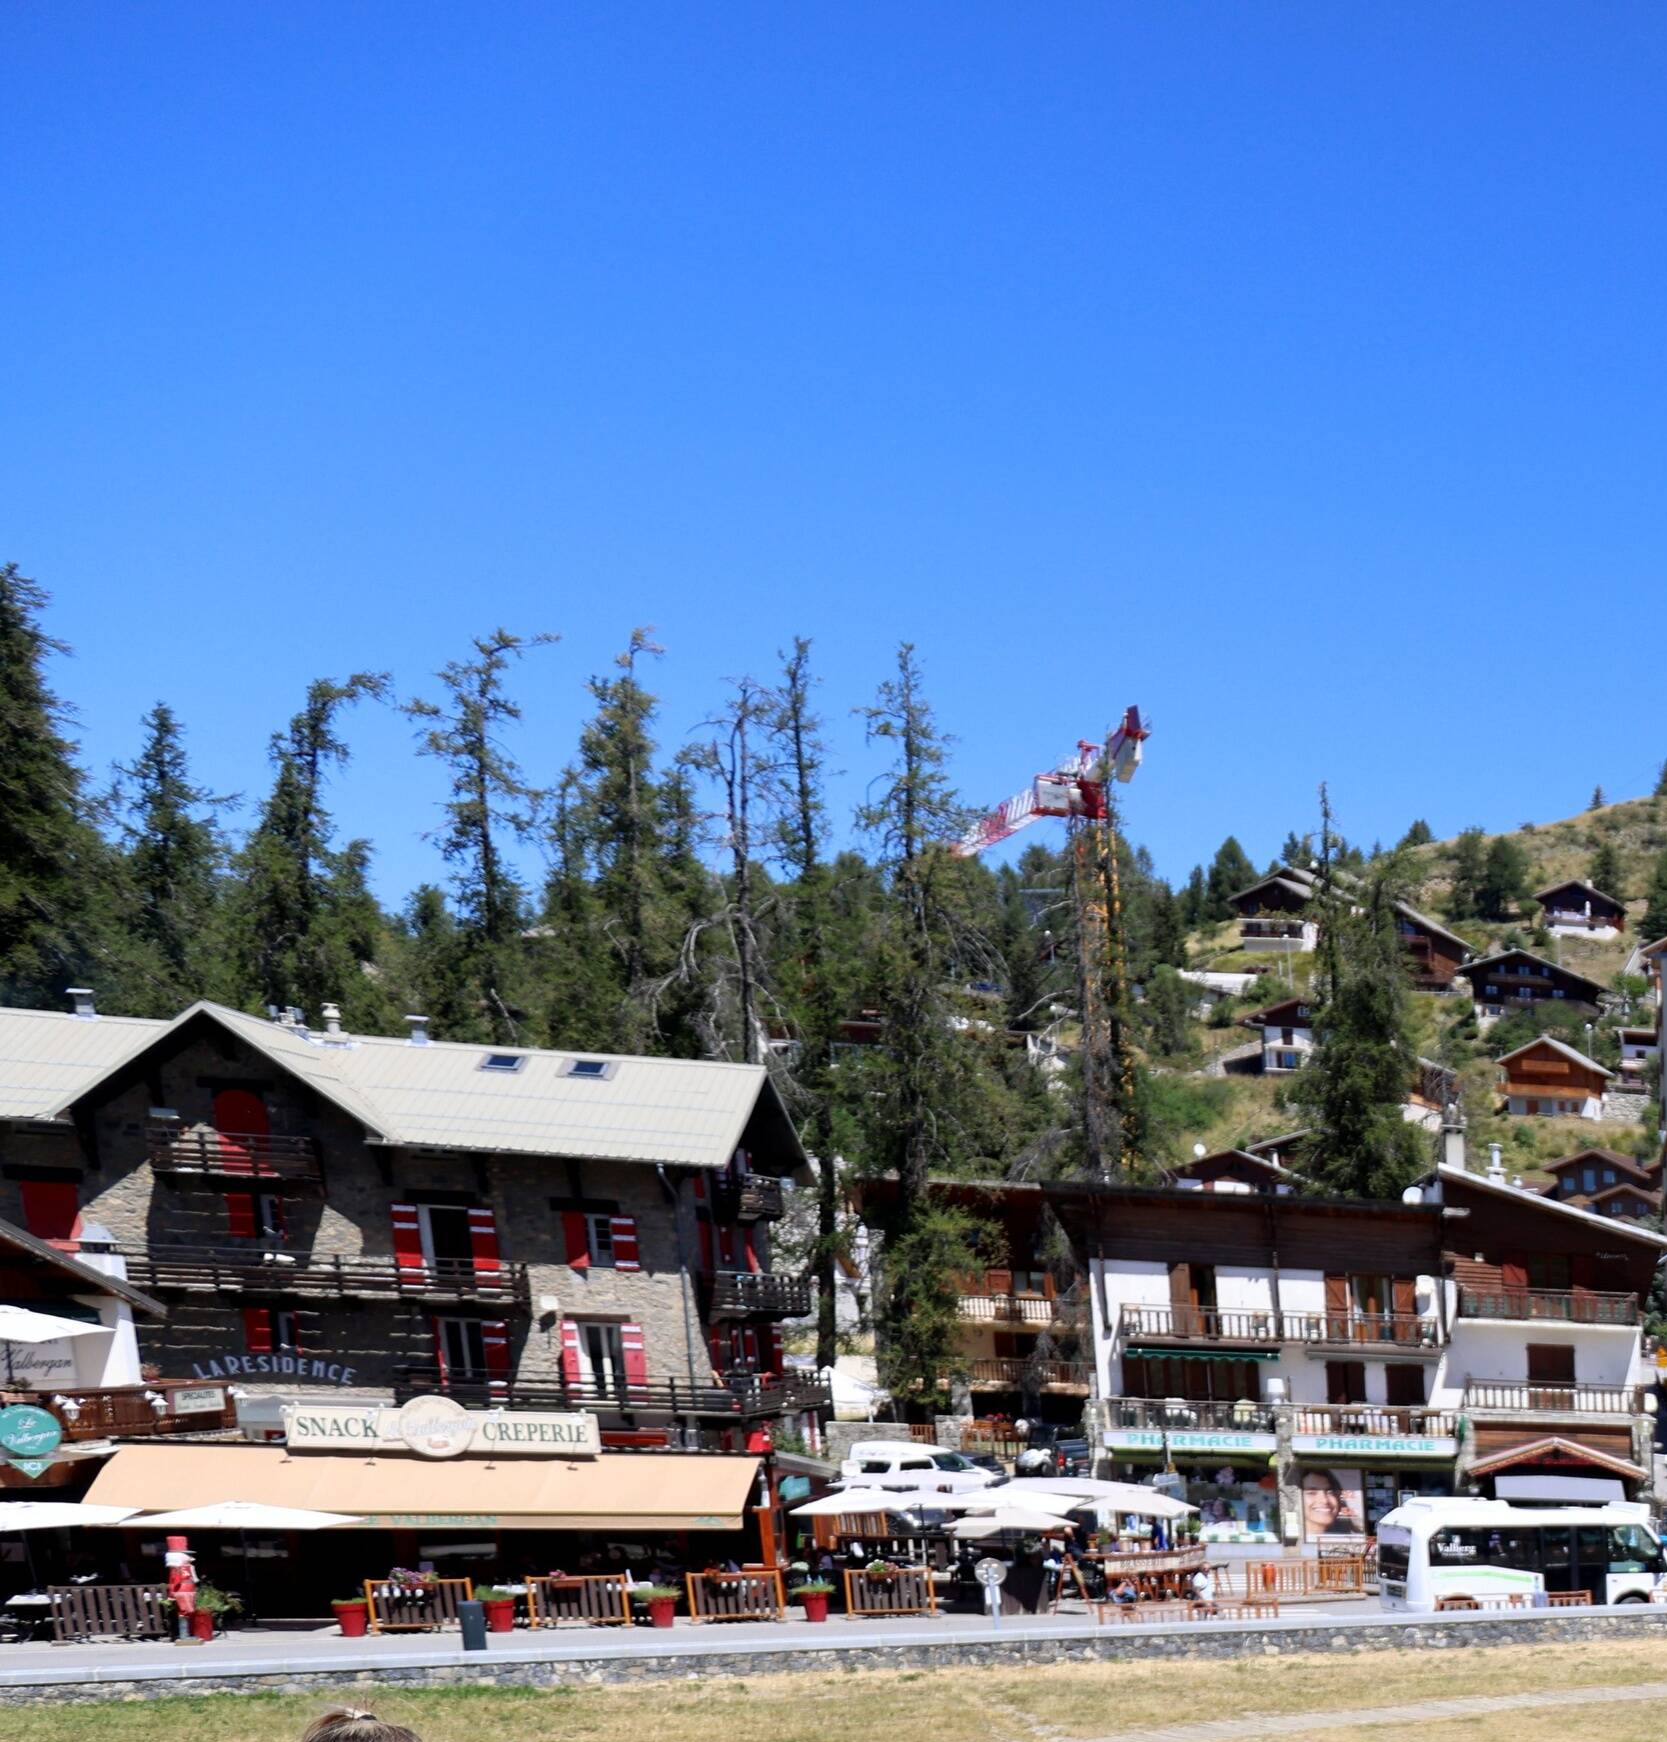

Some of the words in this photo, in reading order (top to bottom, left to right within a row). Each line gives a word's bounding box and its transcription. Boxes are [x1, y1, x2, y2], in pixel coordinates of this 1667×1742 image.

[193, 1359, 225, 1380] LA
[224, 1355, 358, 1385] RESIDENCE
[296, 1416, 379, 1438] SNACK
[482, 1421, 589, 1443] CREPERIE
[1315, 1438, 1436, 1451] PHARMACIE
[1436, 1542, 1477, 1555] Valberg
